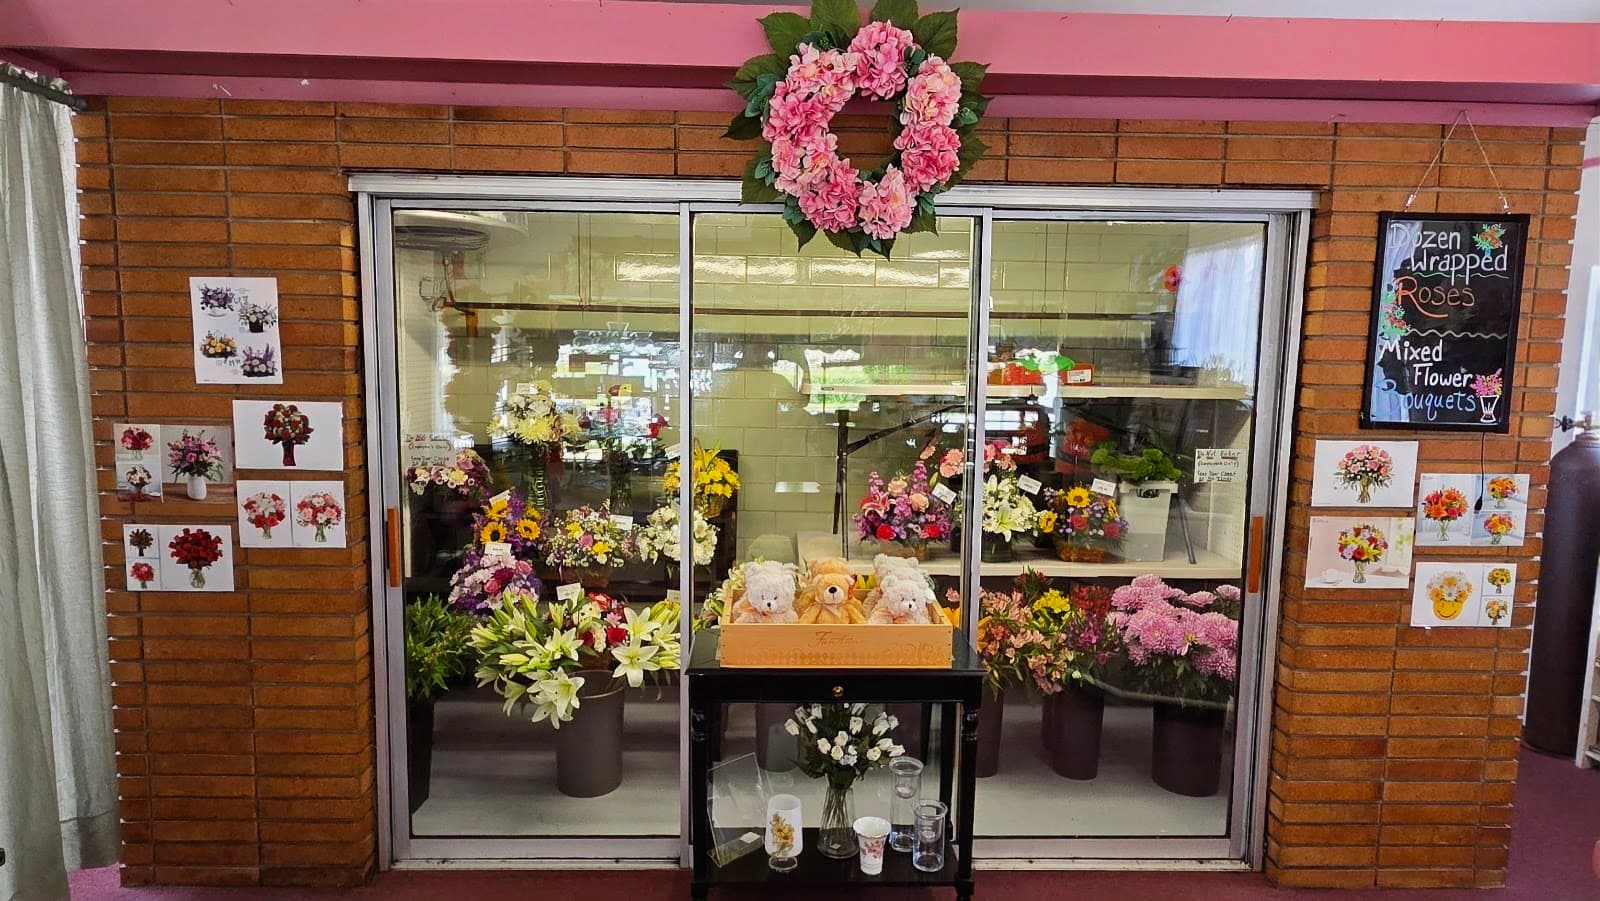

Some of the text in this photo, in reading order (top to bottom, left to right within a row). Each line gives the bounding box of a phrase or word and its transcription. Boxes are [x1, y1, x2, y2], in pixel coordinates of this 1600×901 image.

[1390, 223, 1460, 249] Dozen
[1410, 245, 1508, 286] Wrapped
[1392, 275, 1475, 318] Roses
[1377, 339, 1443, 363] Mixed
[1412, 363, 1473, 387] Flower
